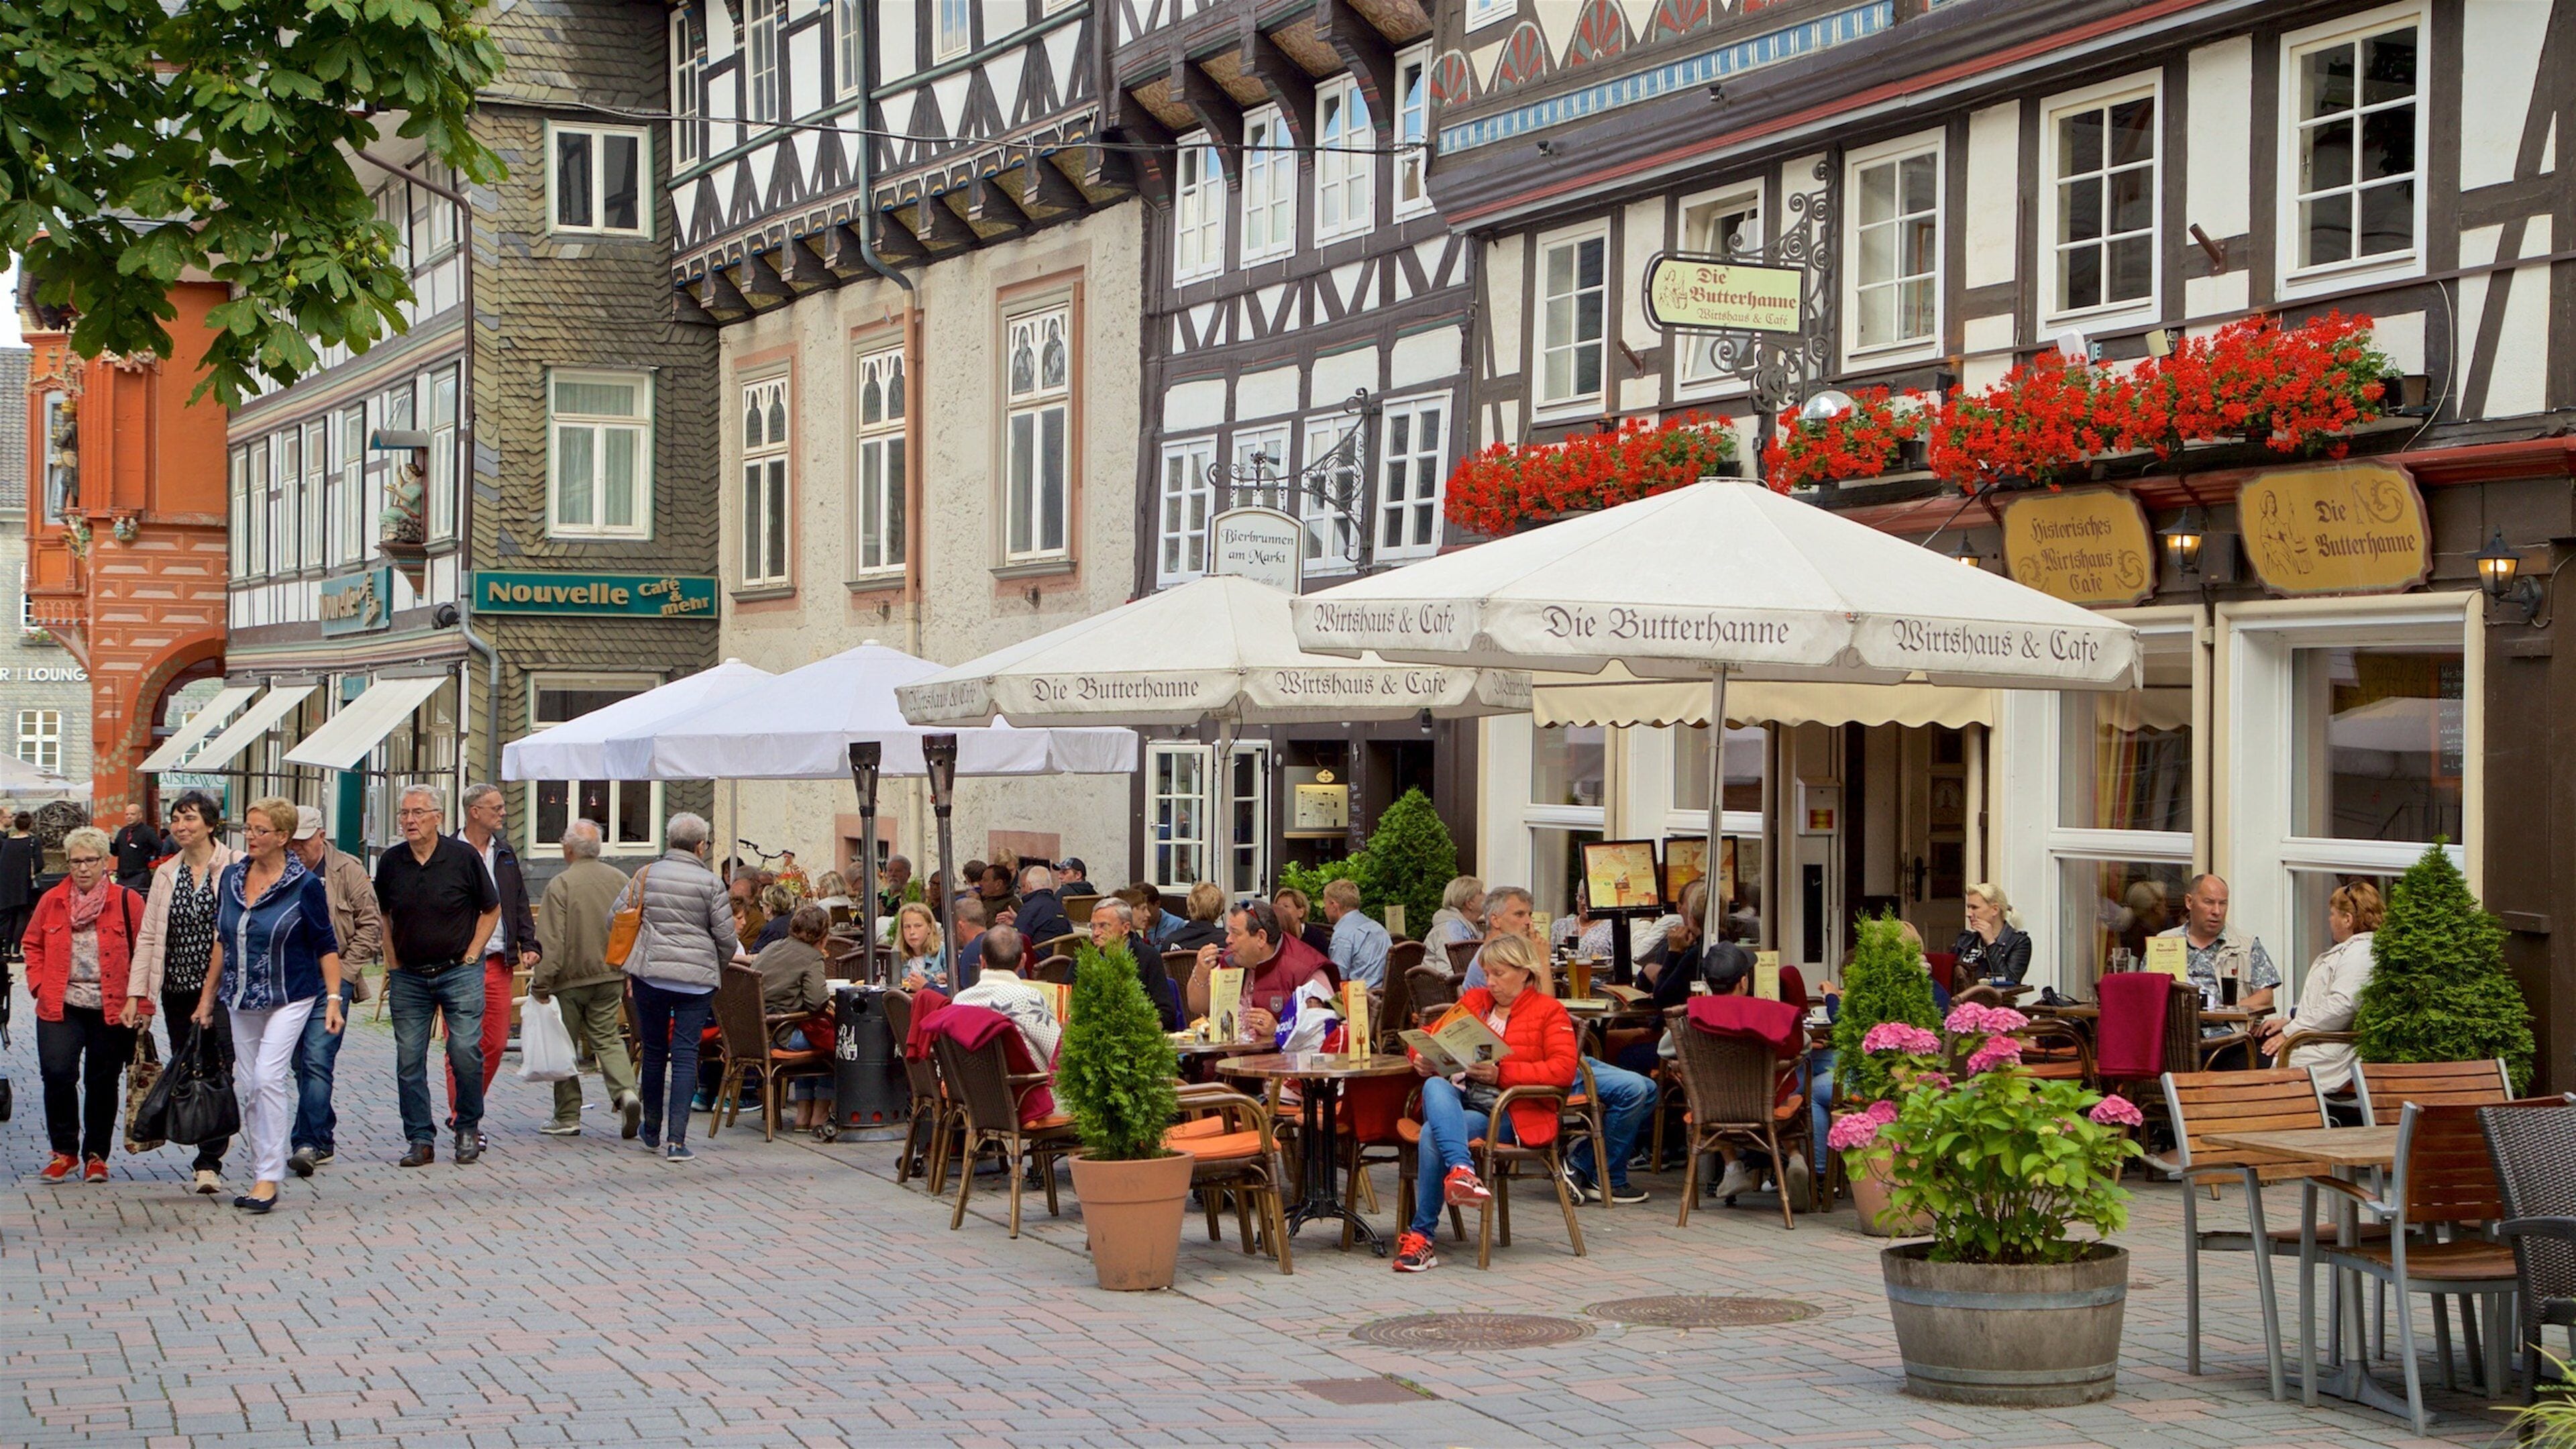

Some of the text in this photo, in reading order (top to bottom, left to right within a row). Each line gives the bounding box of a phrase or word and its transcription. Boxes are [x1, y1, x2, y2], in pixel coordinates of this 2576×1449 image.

[1697, 268, 1727, 284] Die
[1689, 286, 1797, 310] Butterhanne
[1697, 308, 1788, 326] Wirtshaus & Café
[2315, 500, 2347, 523] Die
[1221, 529, 1294, 545] Bierbrunnen
[2031, 515, 2112, 546] Historisches
[1228, 549, 1286, 566] am Markt
[2315, 531, 2416, 563] Butterhanne
[2041, 547, 2113, 574] Wirtshaus
[489, 582, 629, 604] Nouvelle
[638, 577, 680, 596] Café
[669, 590, 683, 602] &
[661, 597, 709, 616] mehr
[1314, 603, 1454, 639] Wirtshaus & Cafe
[1542, 605, 1789, 649] Die Butterhanne
[1893, 619, 2099, 669] Wirtshaus & Cafe
[1031, 676, 1199, 704] Die Butterhanne
[1275, 671, 1446, 699] Wirtshaus & Cafe
